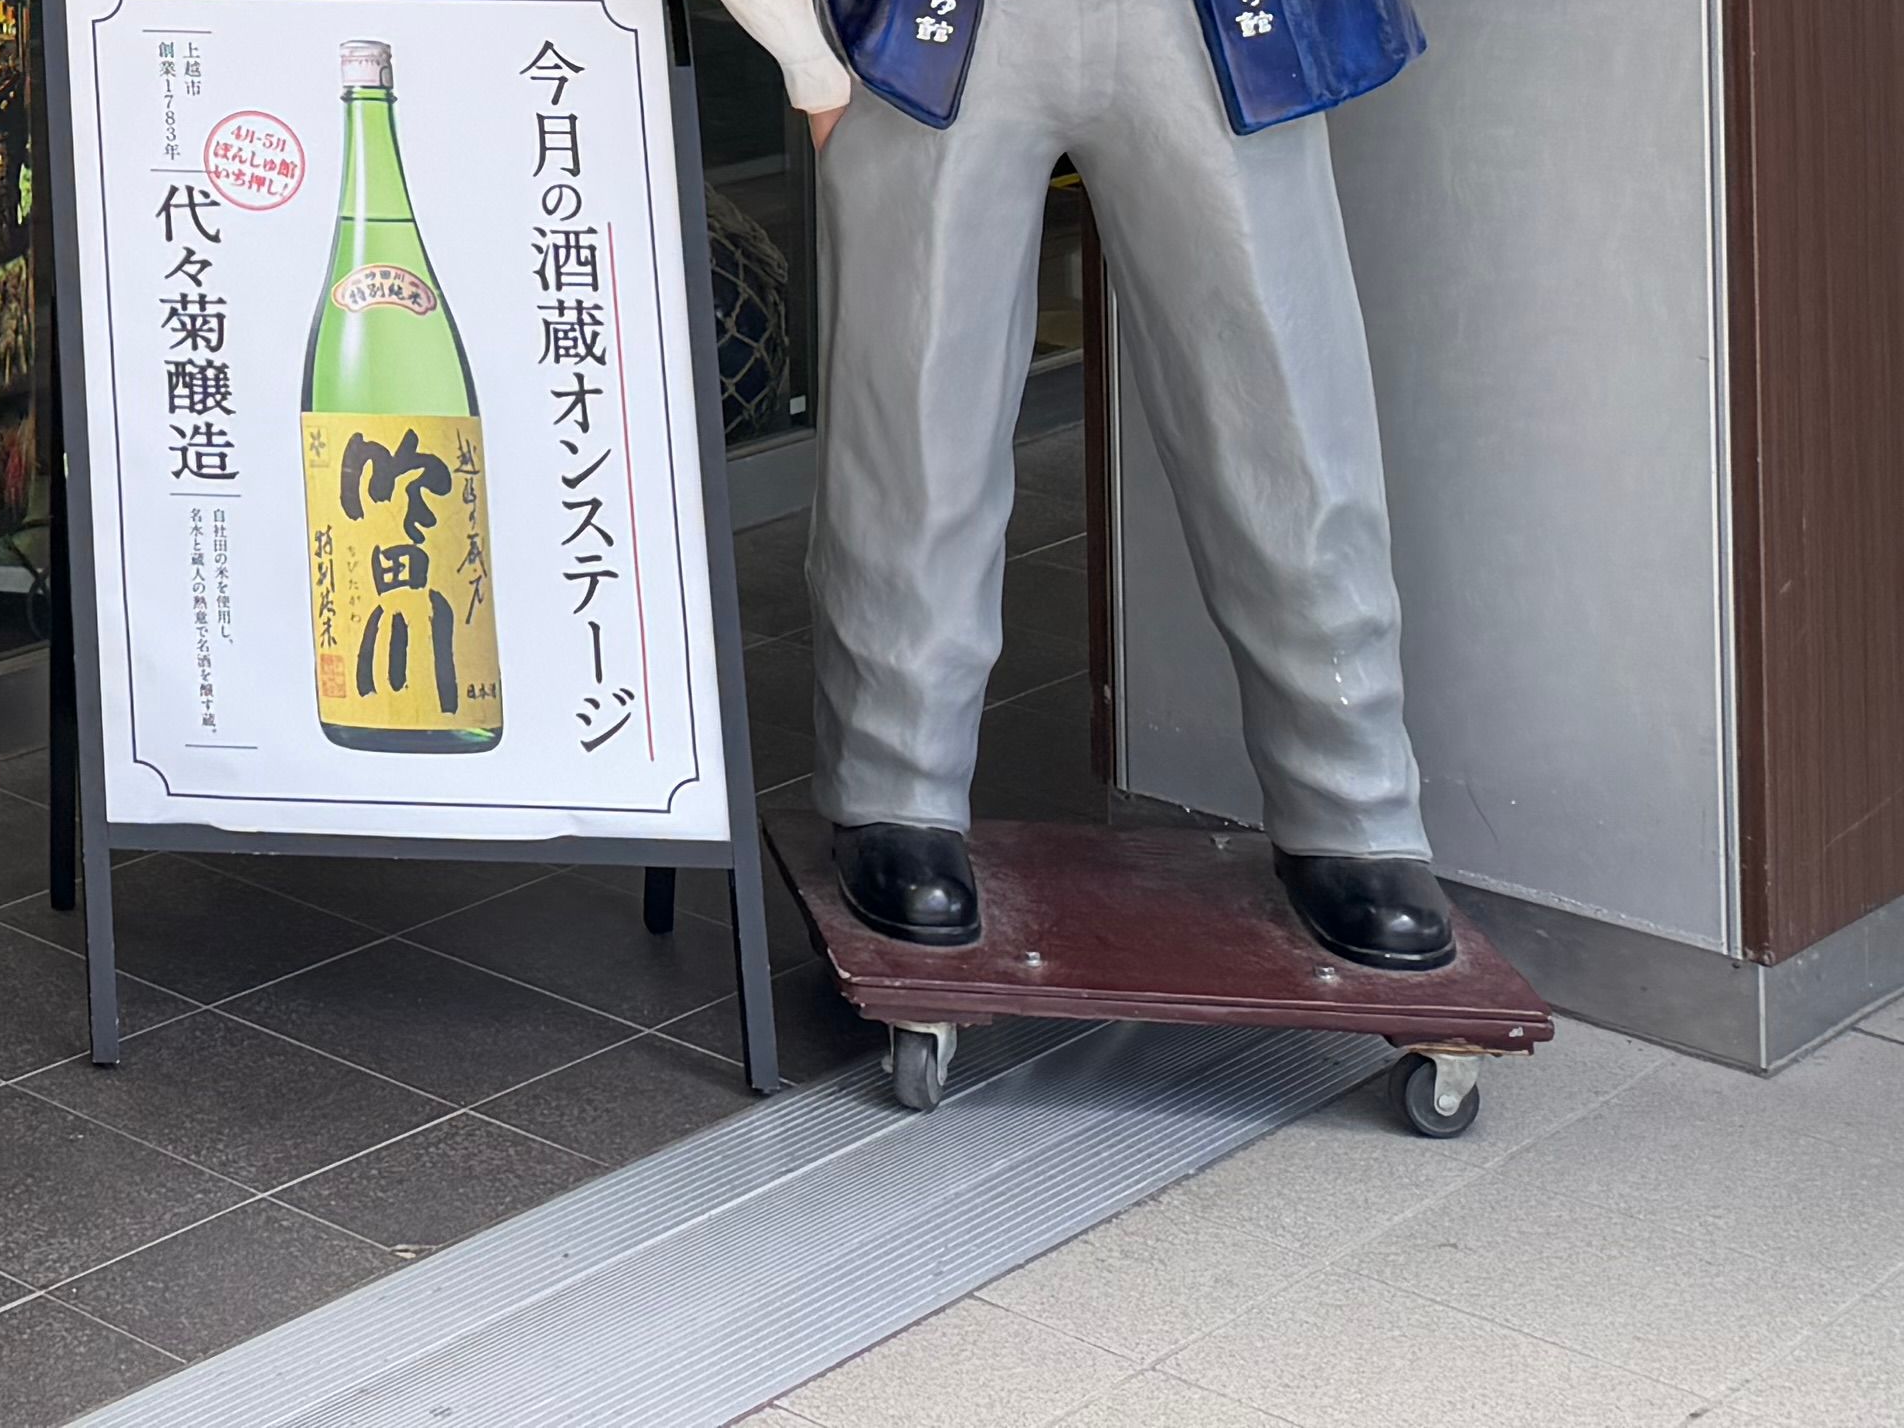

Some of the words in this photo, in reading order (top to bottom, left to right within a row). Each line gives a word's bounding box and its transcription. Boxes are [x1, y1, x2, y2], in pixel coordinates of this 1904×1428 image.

[158, 41, 181, 161] 創業1783年
[183, 42, 202, 97] 上越市
[155, 184, 241, 482] 代々菊醸造
[518, 38, 634, 755] 今月の酒蔵オンステージ
[213, 508, 234, 645] 自社田の米を使用し、
